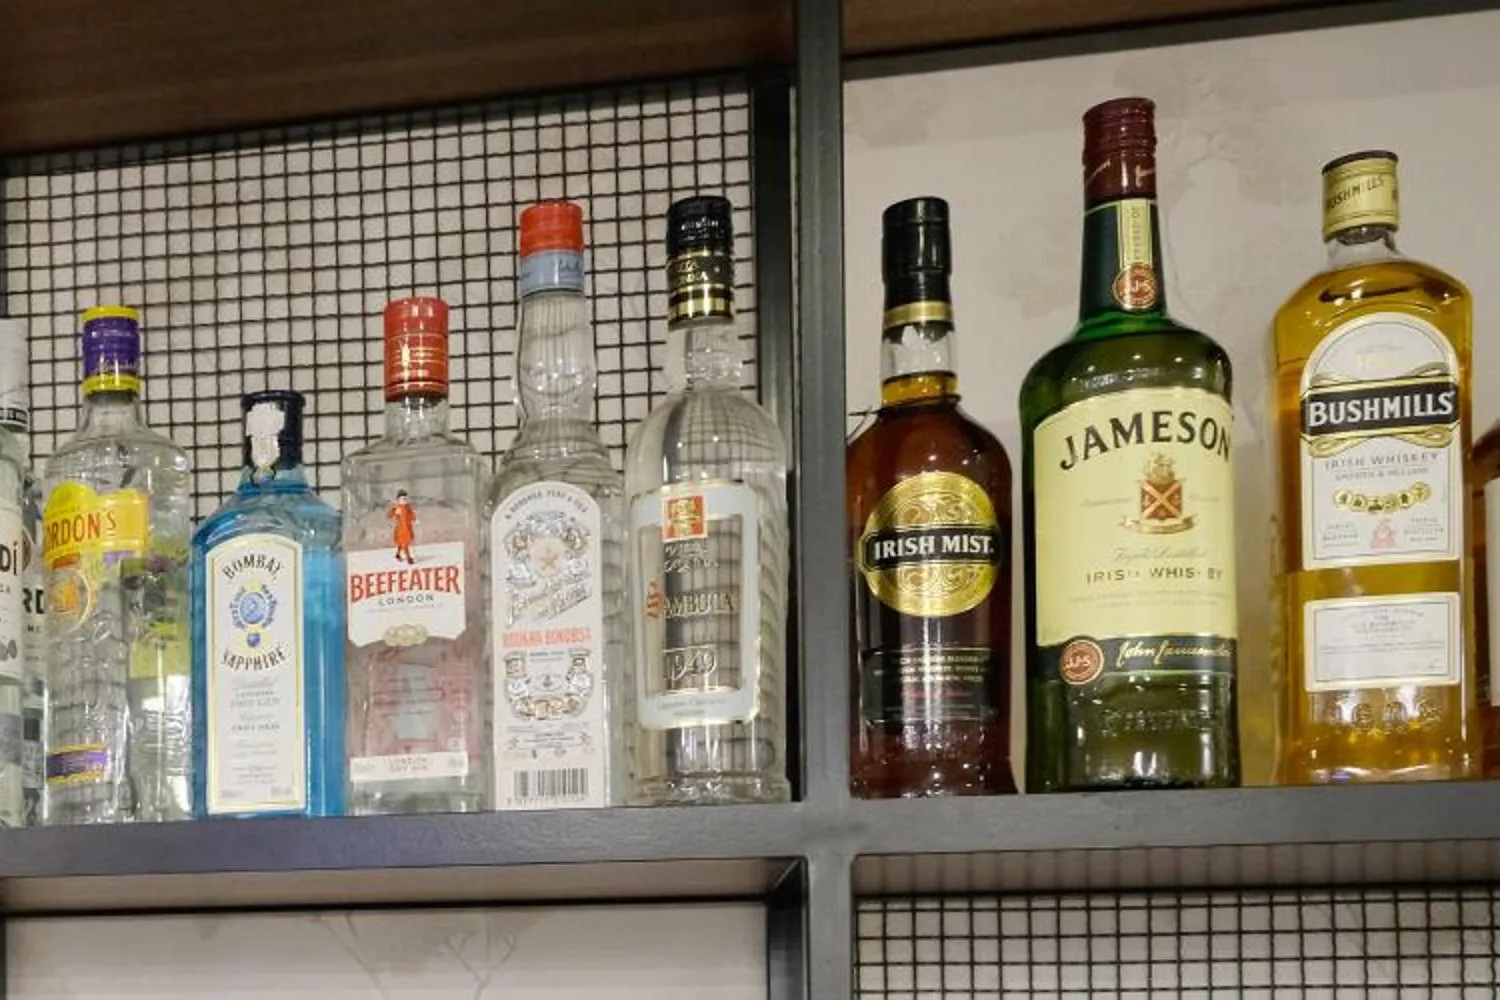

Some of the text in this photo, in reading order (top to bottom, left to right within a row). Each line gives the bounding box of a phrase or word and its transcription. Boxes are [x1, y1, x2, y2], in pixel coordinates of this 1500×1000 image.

[1328, 176, 1385, 209] USHMILLS
[1308, 390, 1455, 427] BUSHMILLS
[1060, 411, 1231, 471] JAMESON
[874, 534, 992, 560] IRISH MIST
[222, 553, 284, 581] BOMBAY
[350, 565, 461, 603] BEEFEATER
[378, 594, 435, 606] LONDON
[222, 644, 288, 672] SAPPHIRE
